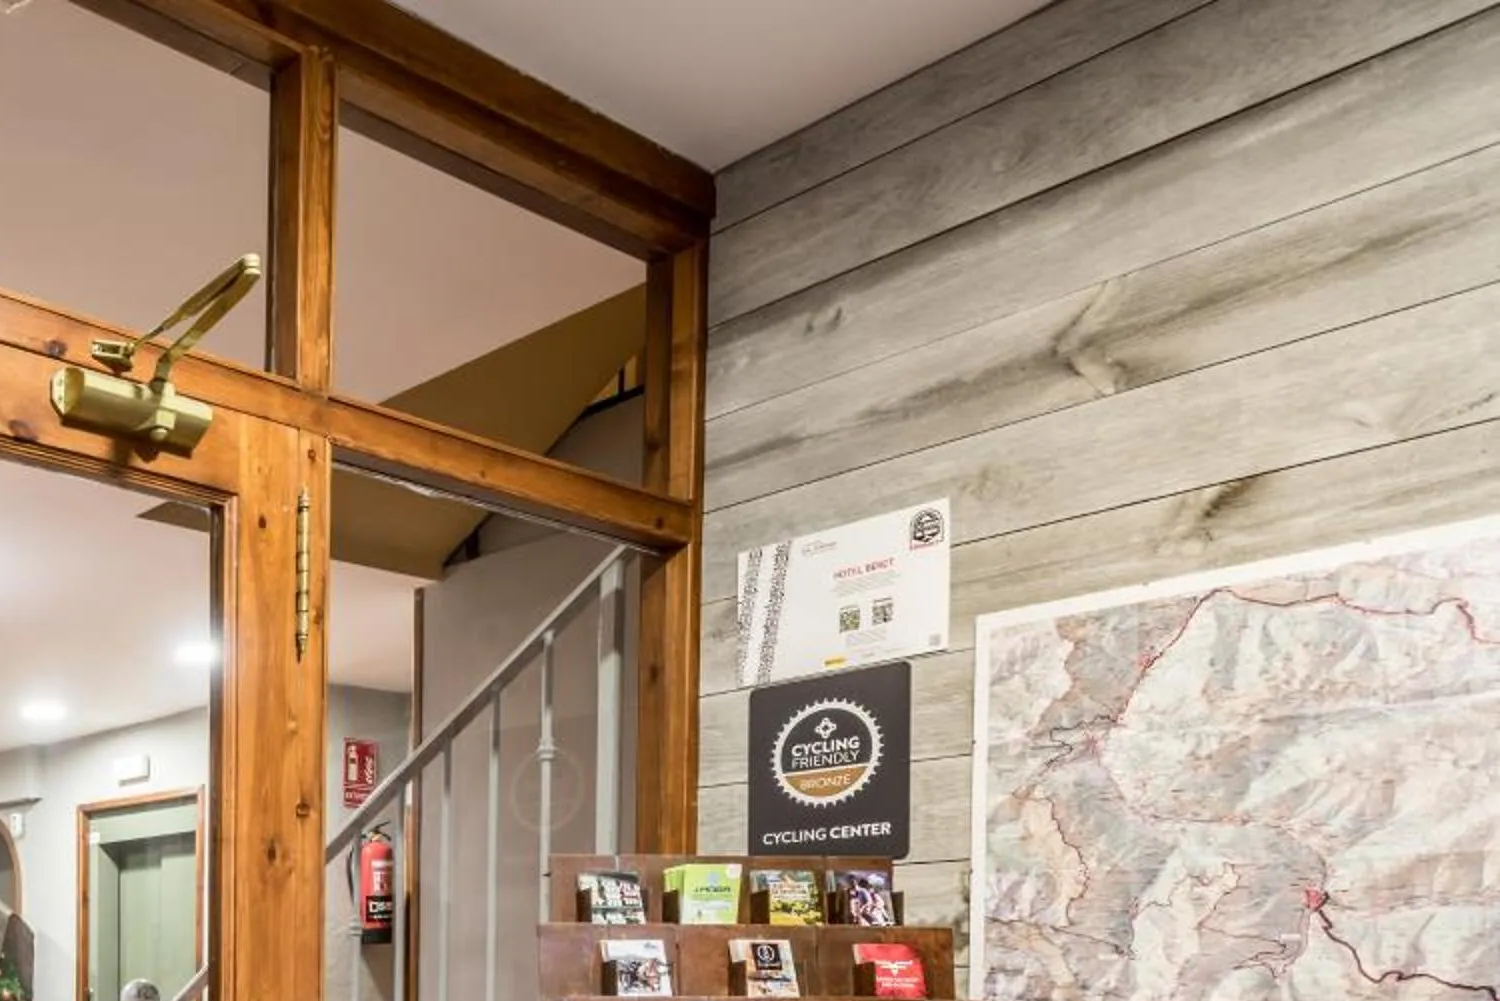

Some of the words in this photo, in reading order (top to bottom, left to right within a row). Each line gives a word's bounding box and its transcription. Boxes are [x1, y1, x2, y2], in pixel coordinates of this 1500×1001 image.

[791, 736, 861, 757] CYCLING
[791, 750, 861, 769] FRIENDLY
[763, 828, 827, 845] CYCLING
[829, 821, 892, 839] CENTER
